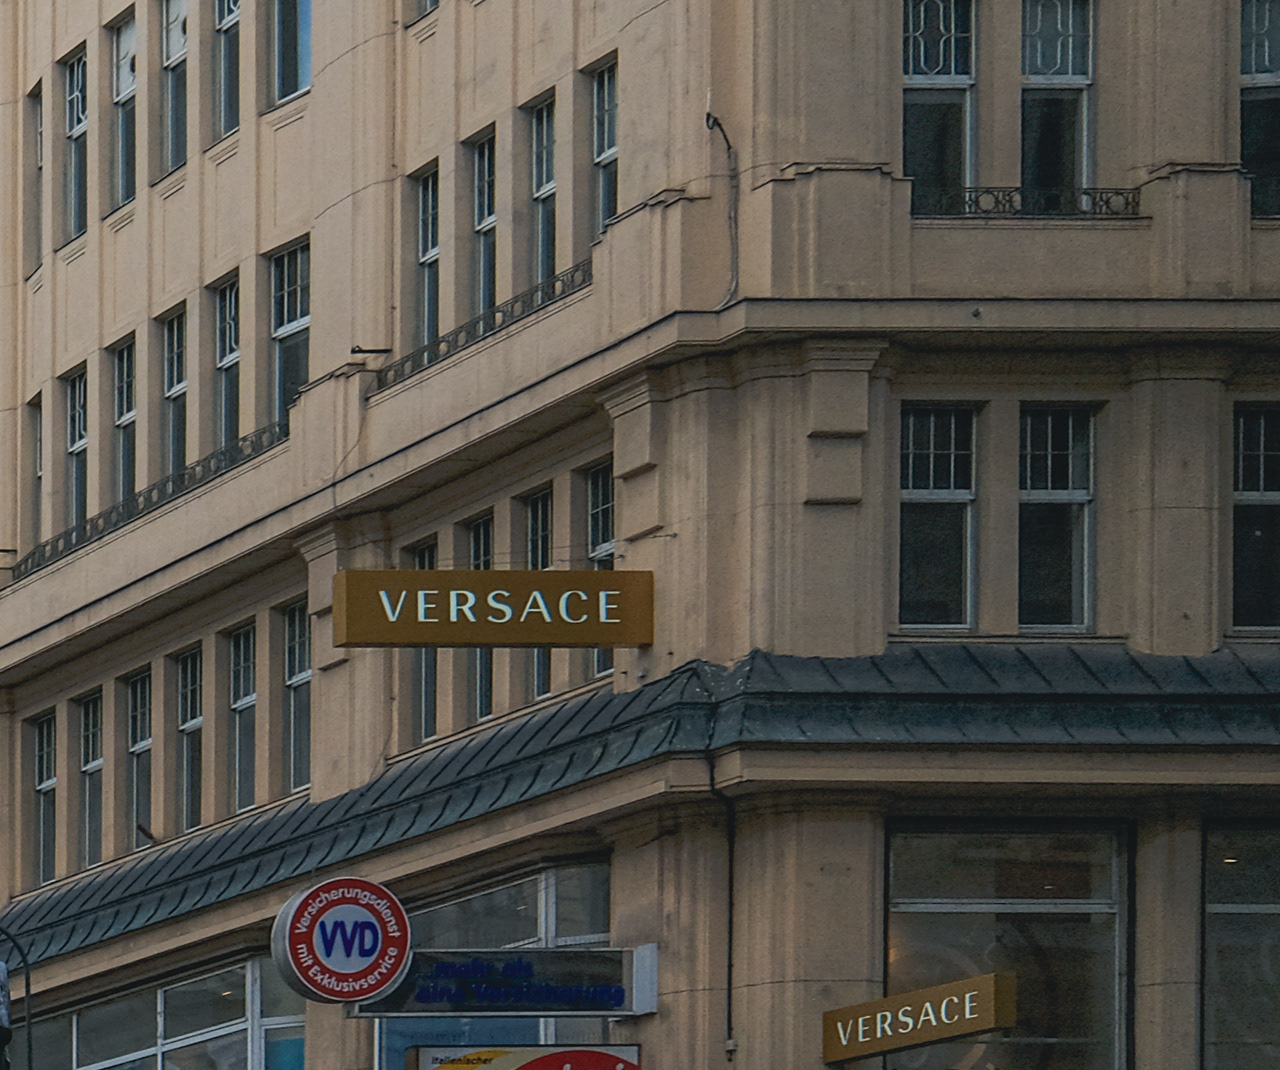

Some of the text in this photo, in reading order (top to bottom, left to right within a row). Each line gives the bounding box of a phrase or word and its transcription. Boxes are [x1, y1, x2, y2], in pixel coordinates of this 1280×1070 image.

[378, 589, 622, 624] VERSACE
[294, 887, 402, 938] Versicherungsdienst
[318, 920, 379, 958] VVD
[296, 943, 399, 992] mit Exklusivservice
[836, 991, 979, 1047] VERSACE
